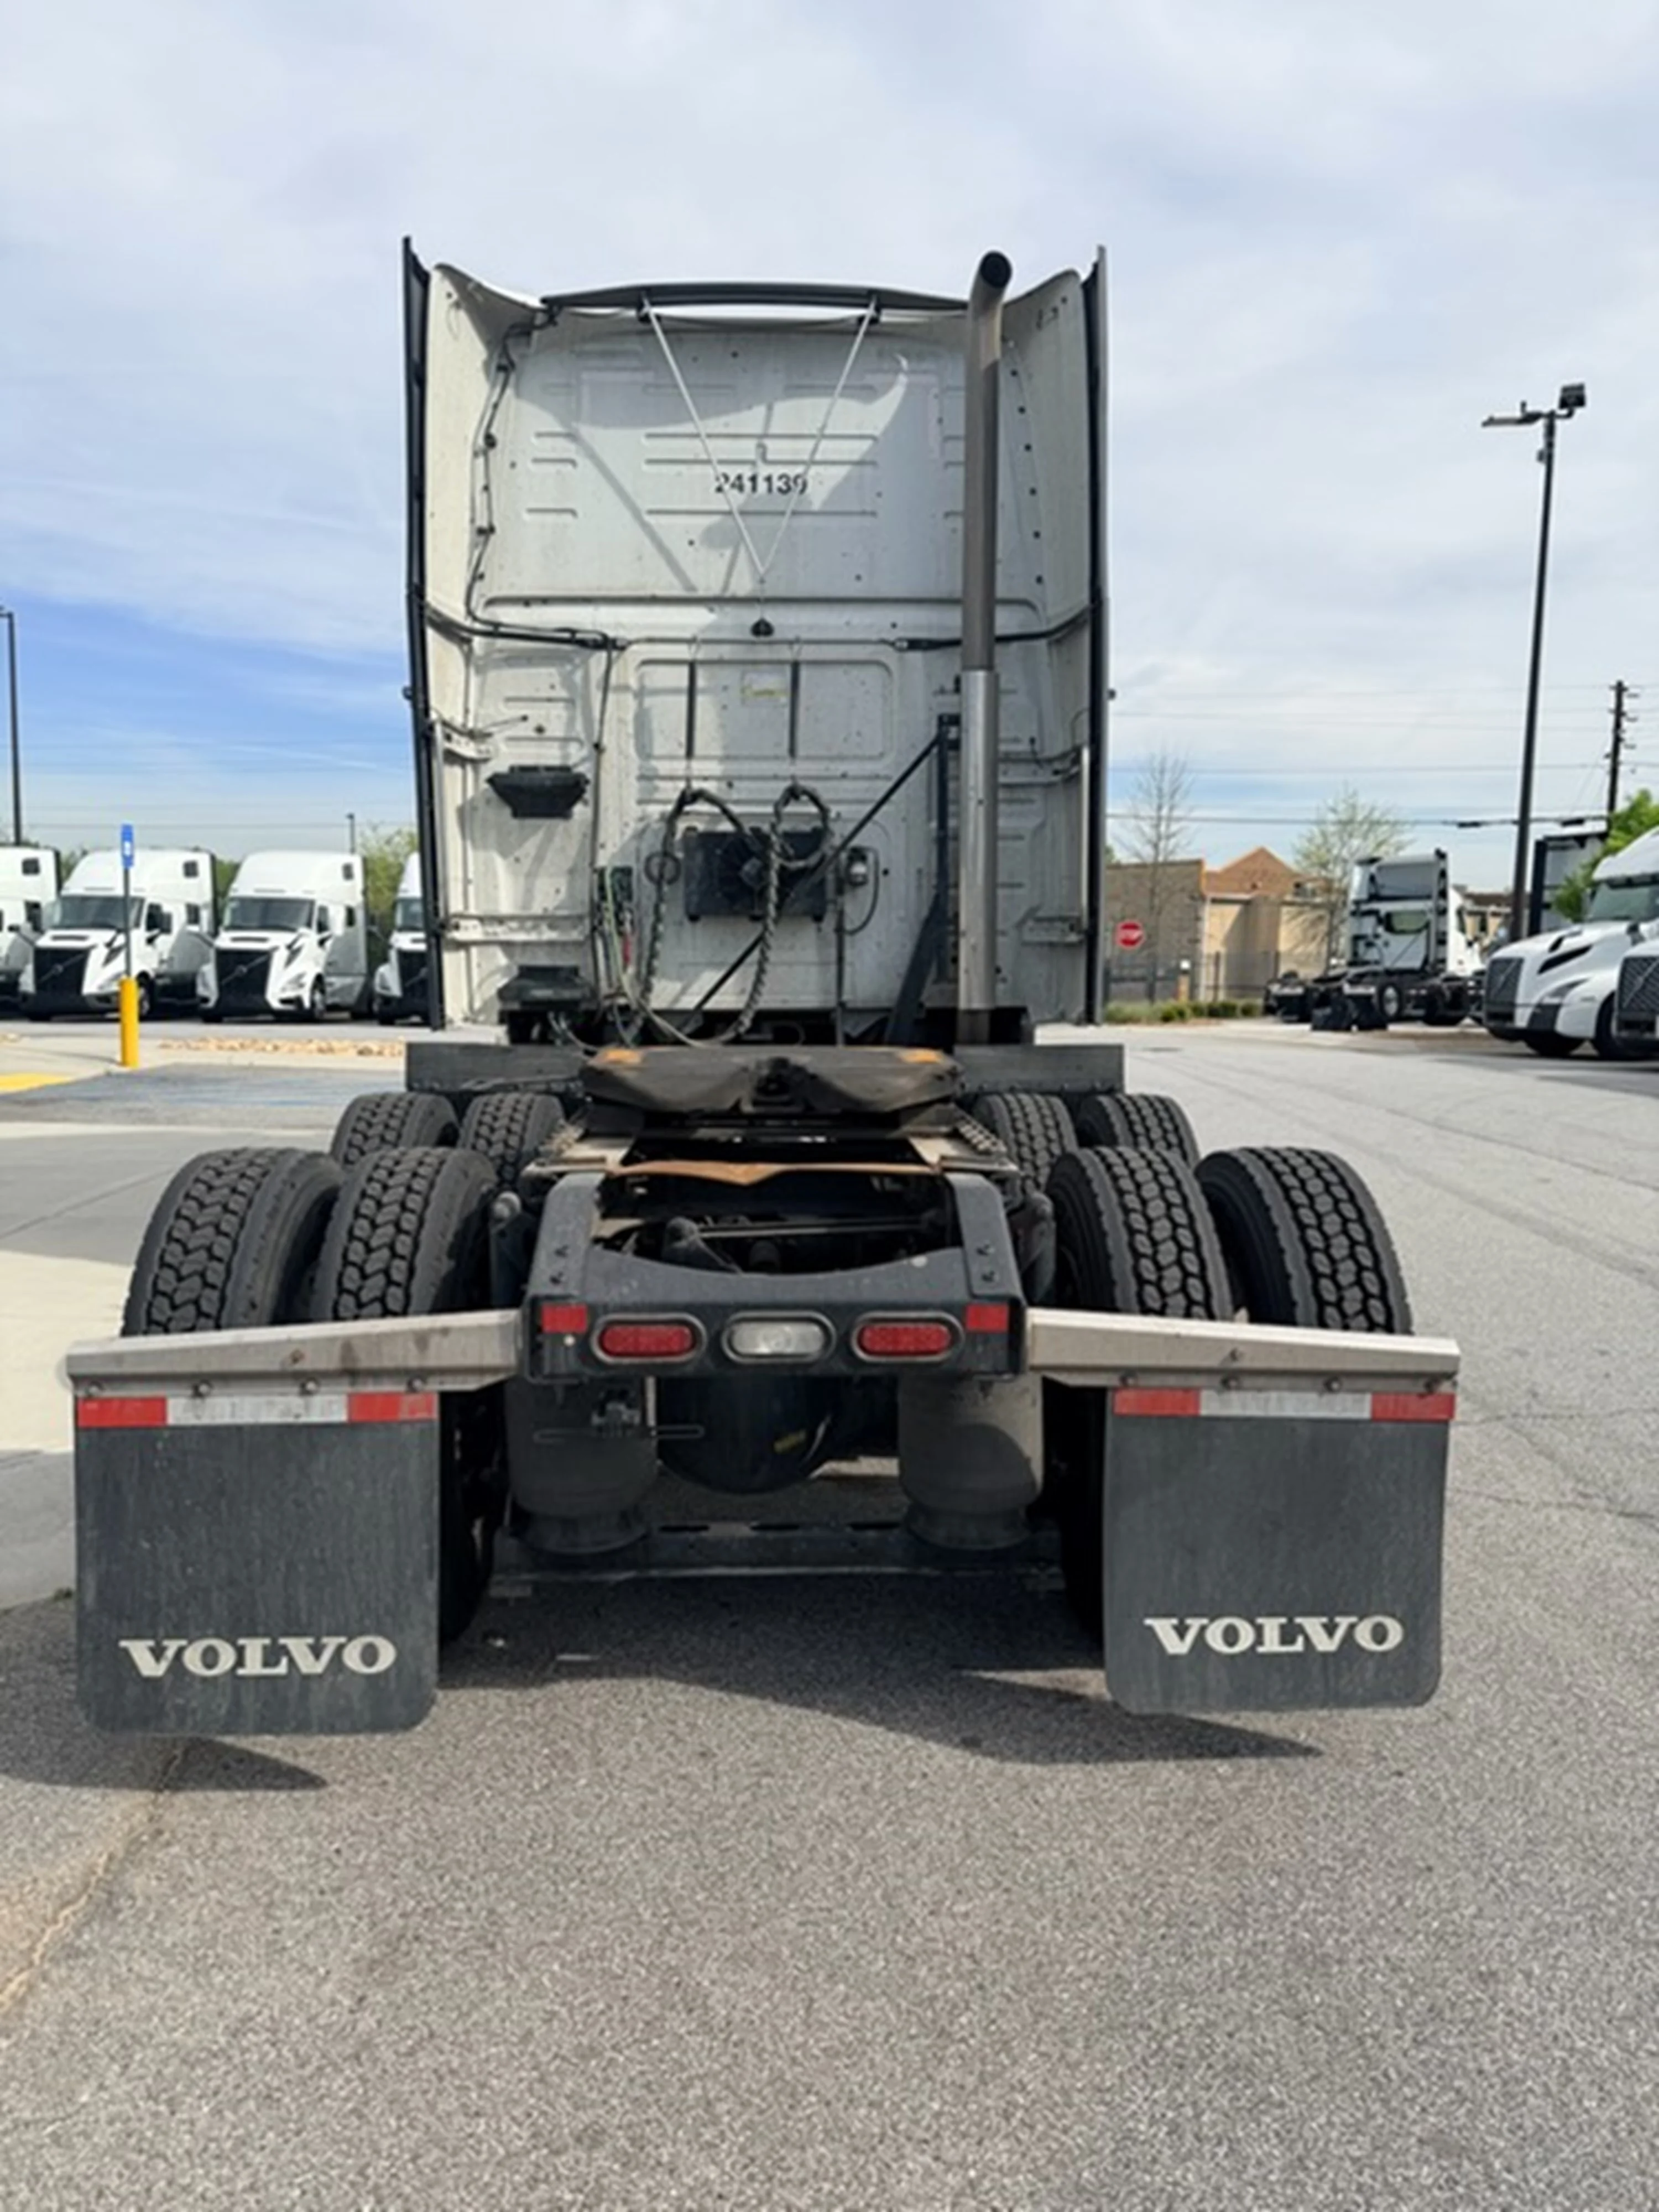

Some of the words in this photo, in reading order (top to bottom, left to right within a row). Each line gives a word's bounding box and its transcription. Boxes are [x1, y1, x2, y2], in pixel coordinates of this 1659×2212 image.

[715, 472, 808, 495] 241139
[1144, 1615, 1404, 1655] VOLVO
[118, 1634, 397, 1677] VOLVO
